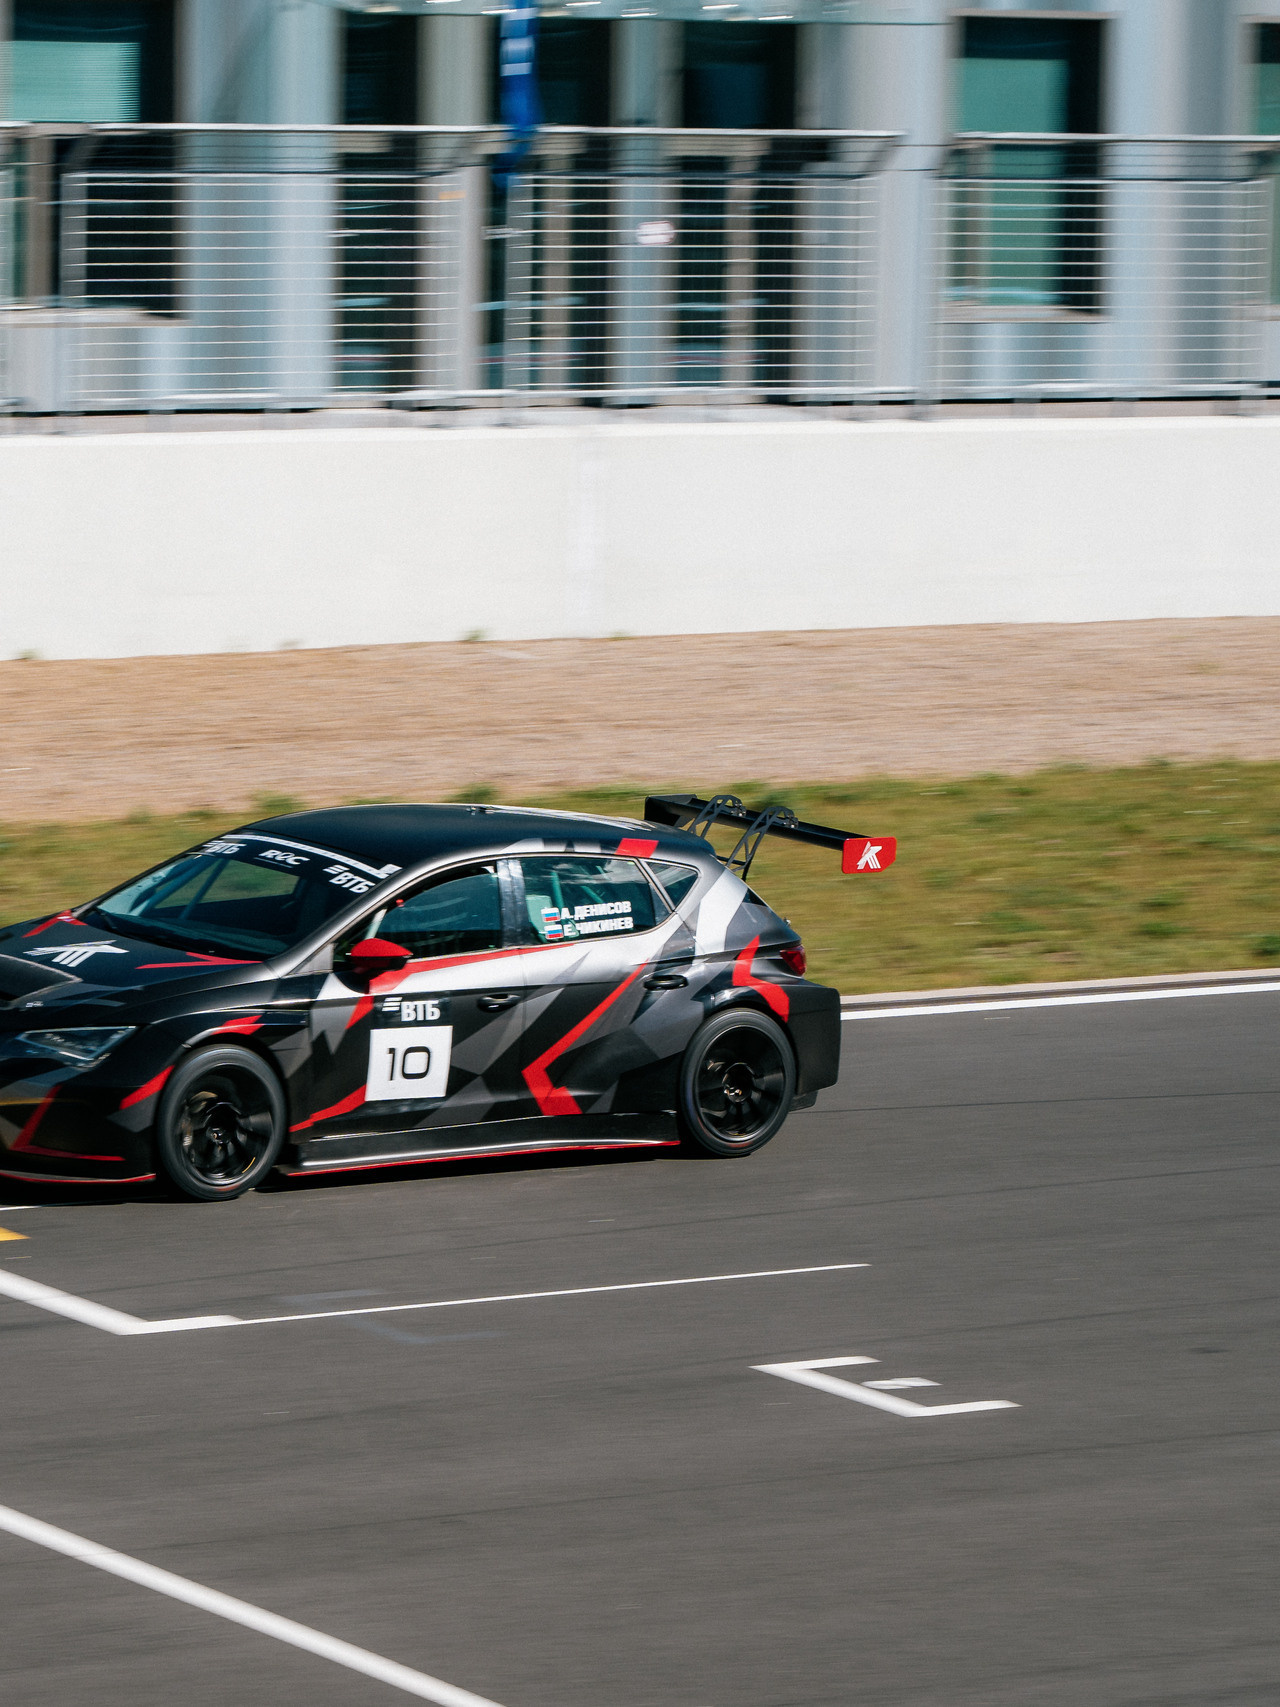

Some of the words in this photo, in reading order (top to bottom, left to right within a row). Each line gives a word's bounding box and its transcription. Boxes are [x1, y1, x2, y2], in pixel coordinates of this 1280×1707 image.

[328, 872, 376, 894] ВТБ
[401, 1000, 441, 1022] ВТБ
[387, 1045, 431, 1081] 10
